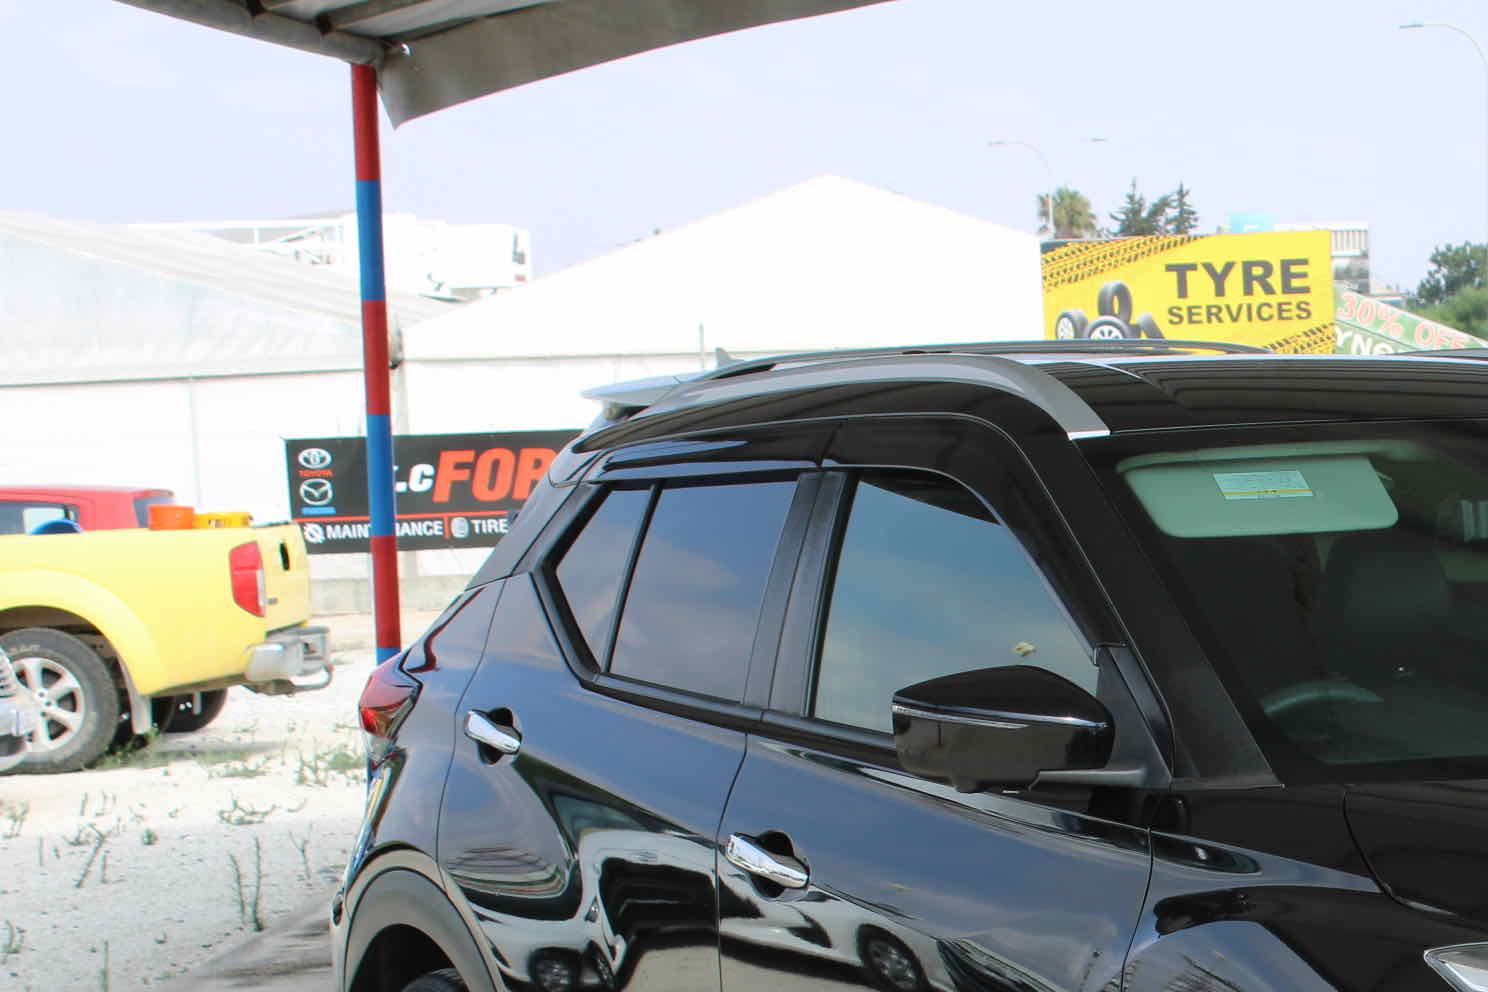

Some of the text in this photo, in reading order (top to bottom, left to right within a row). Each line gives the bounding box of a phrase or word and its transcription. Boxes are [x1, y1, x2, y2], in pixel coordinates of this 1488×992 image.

[1165, 258, 1311, 299] TYRE
[1167, 300, 1313, 326] SERVICES
[1337, 294, 1404, 337] 30%
[471, 518, 509, 534] TIRE
